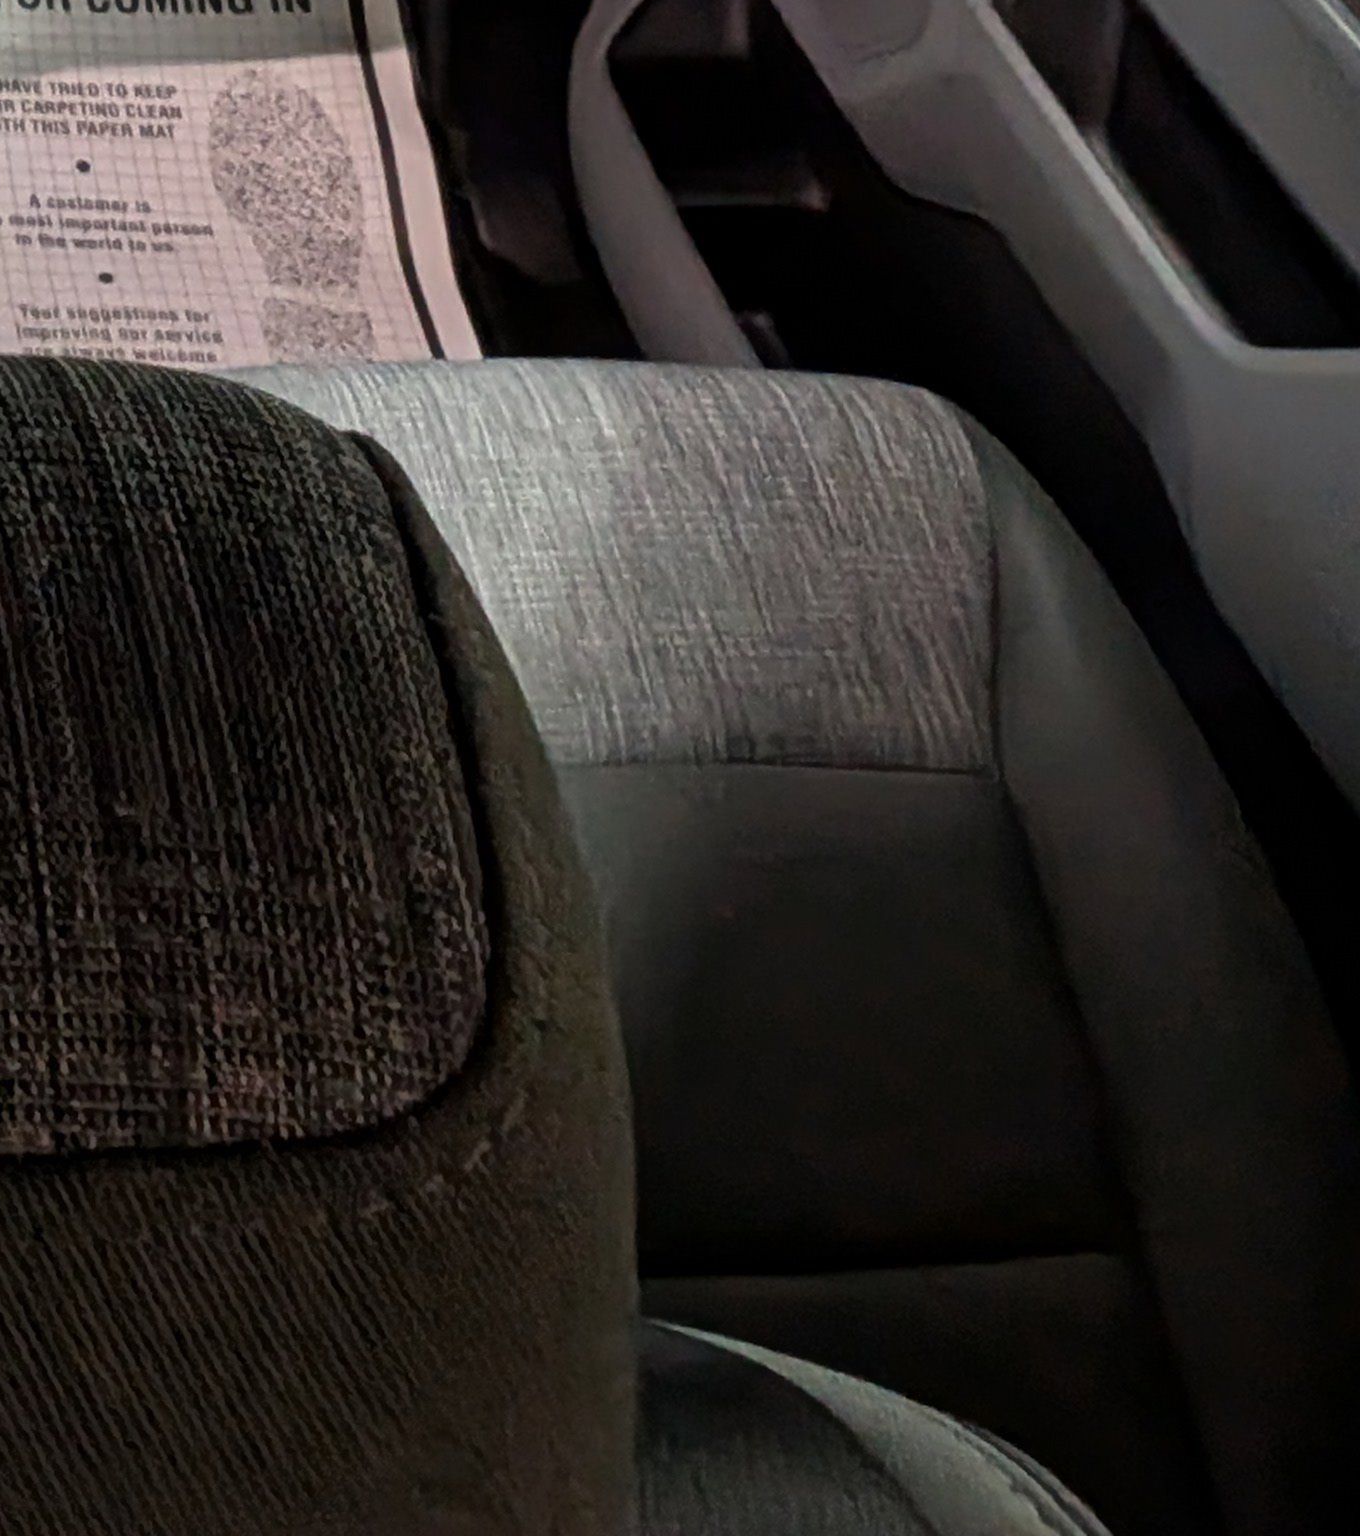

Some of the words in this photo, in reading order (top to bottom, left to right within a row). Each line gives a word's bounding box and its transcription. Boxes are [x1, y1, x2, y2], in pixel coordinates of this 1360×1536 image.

[48, 81, 99, 97] TRIED
[106, 83, 128, 98] TO
[134, 84, 178, 100] KEEP
[20, 100, 120, 118] CARPETING
[126, 103, 182, 119] CLEAN
[30, 118, 70, 135] THIS
[76, 120, 133, 138] PAPER
[138, 122, 176, 139] MAT
[30, 194, 41, 209] A
[47, 195, 129, 212] customer
[135, 200, 151, 213] is
[9, 213, 53, 227] most
[58, 216, 147, 233] important
[152, 221, 214, 237] person
[38, 233, 67, 248] the
[72, 236, 123, 250] world
[129, 239, 147, 251] to
